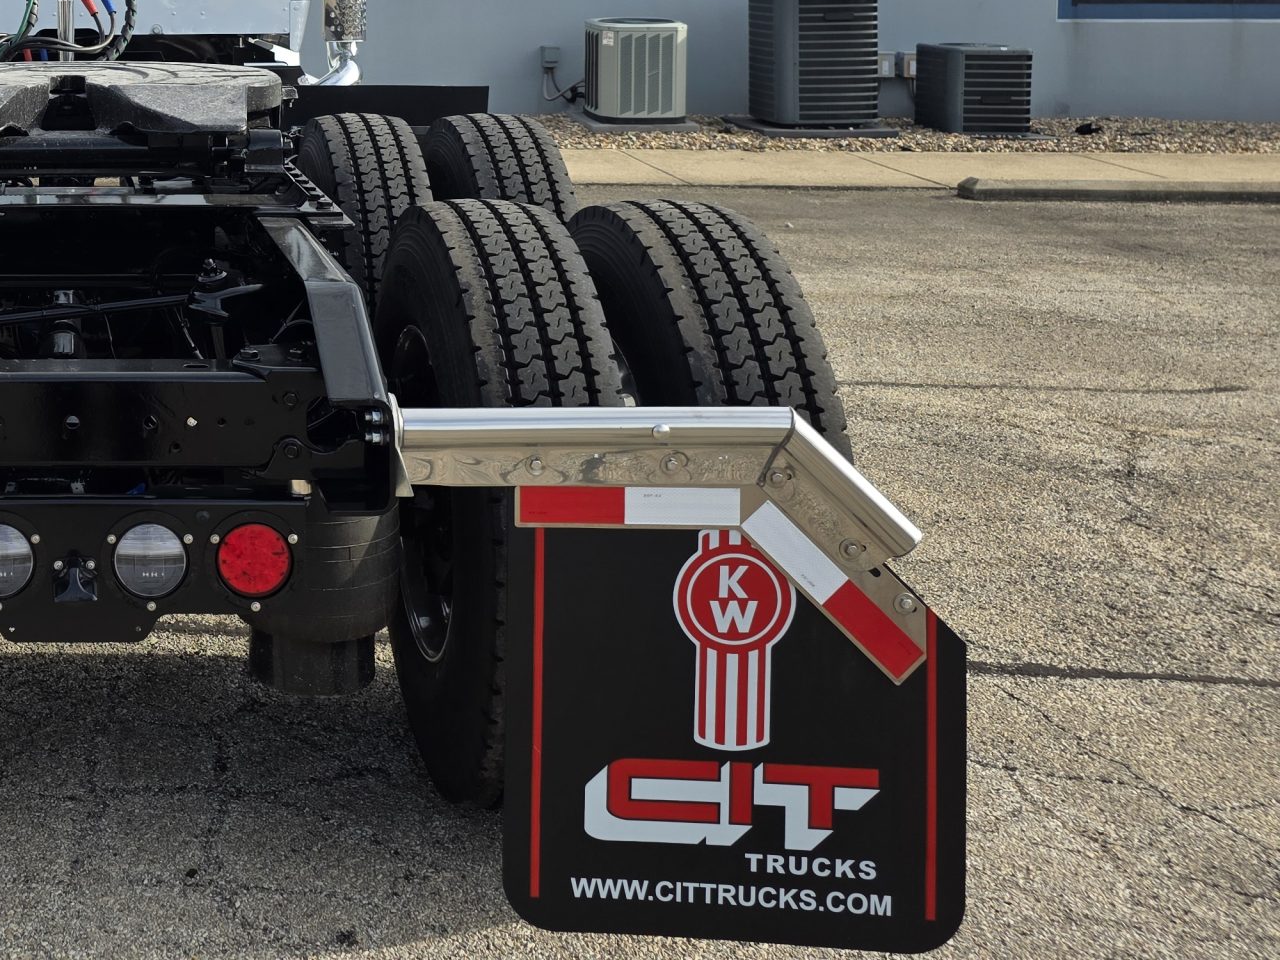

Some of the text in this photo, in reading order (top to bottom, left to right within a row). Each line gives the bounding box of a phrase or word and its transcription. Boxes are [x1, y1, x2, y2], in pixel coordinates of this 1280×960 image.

[605, 757, 880, 831] CIT
[744, 853, 877, 880] TRUCKS
[570, 876, 893, 918] WWW.CITTRUCKS.COM
